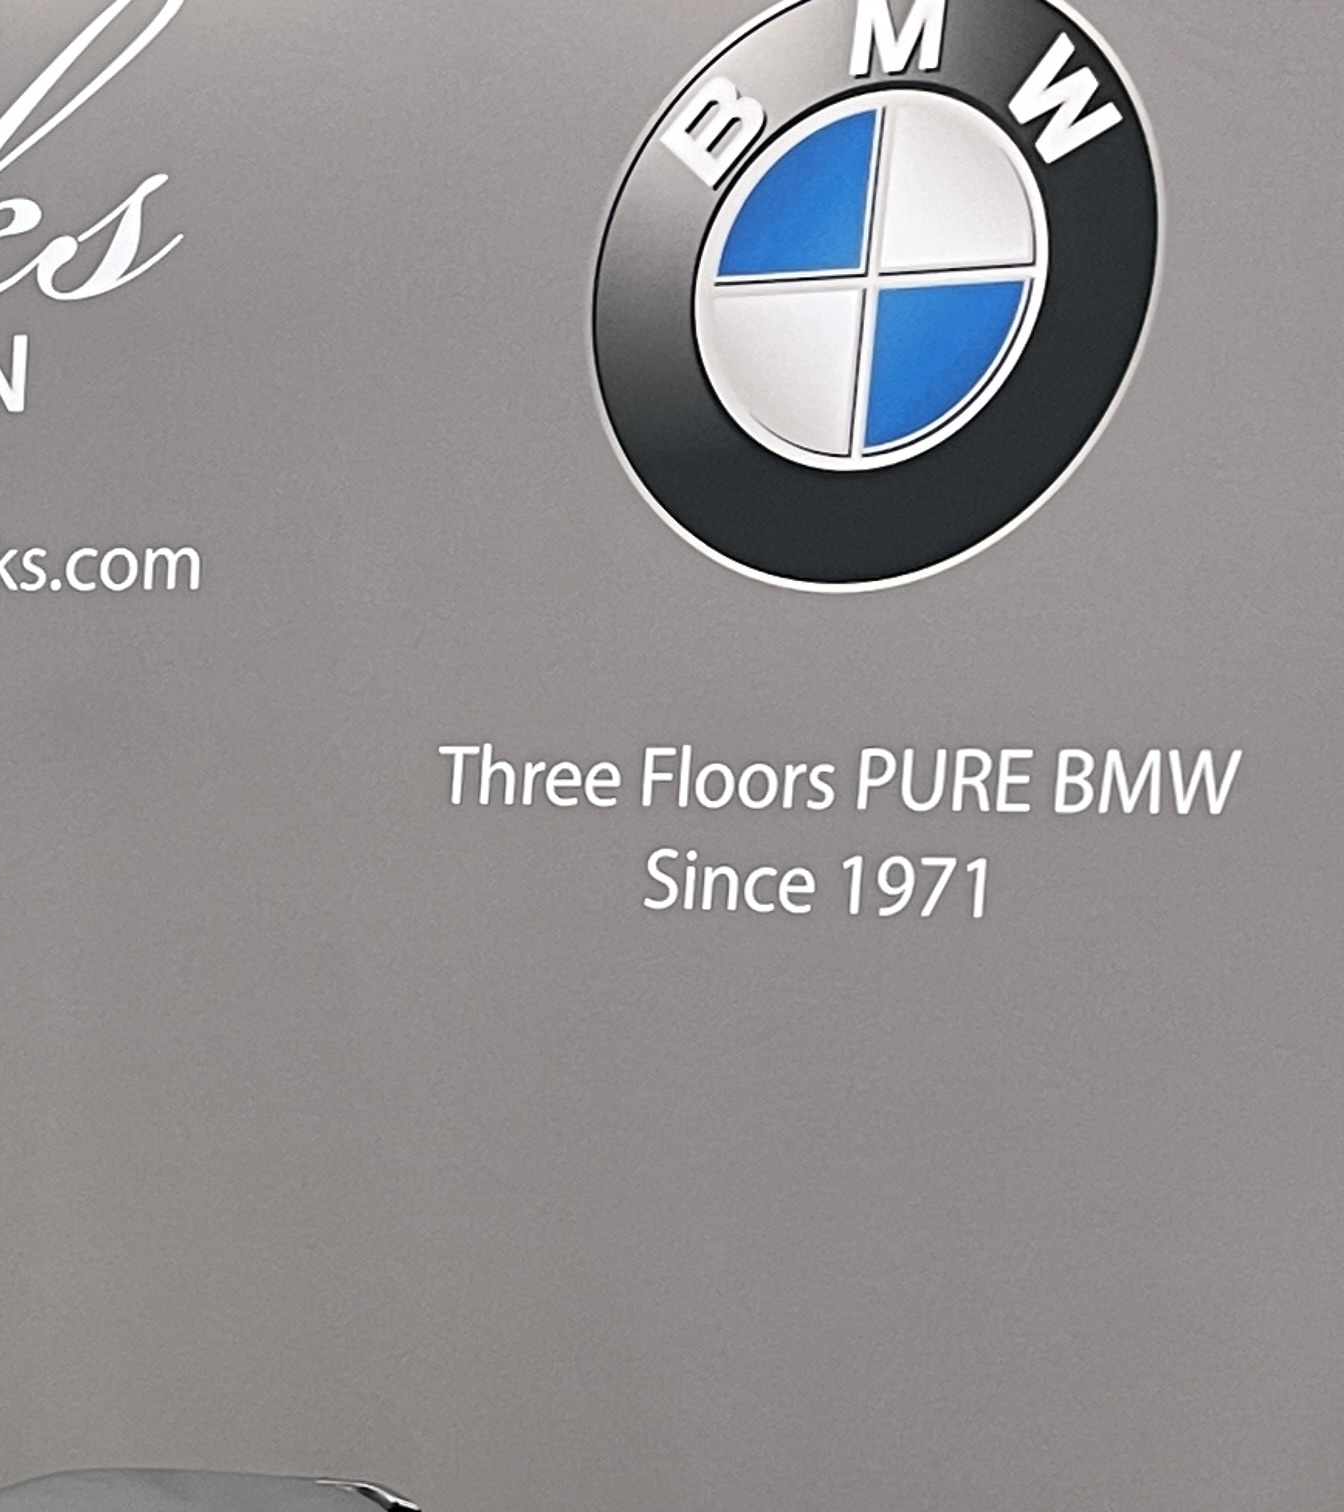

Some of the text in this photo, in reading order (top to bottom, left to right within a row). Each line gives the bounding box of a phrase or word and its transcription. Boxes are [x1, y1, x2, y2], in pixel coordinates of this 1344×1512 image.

[659, 0, 1123, 190] BMW
[437, 742, 1244, 816] Three Floors PURE BMW
[642, 847, 988, 919] Since 1971
